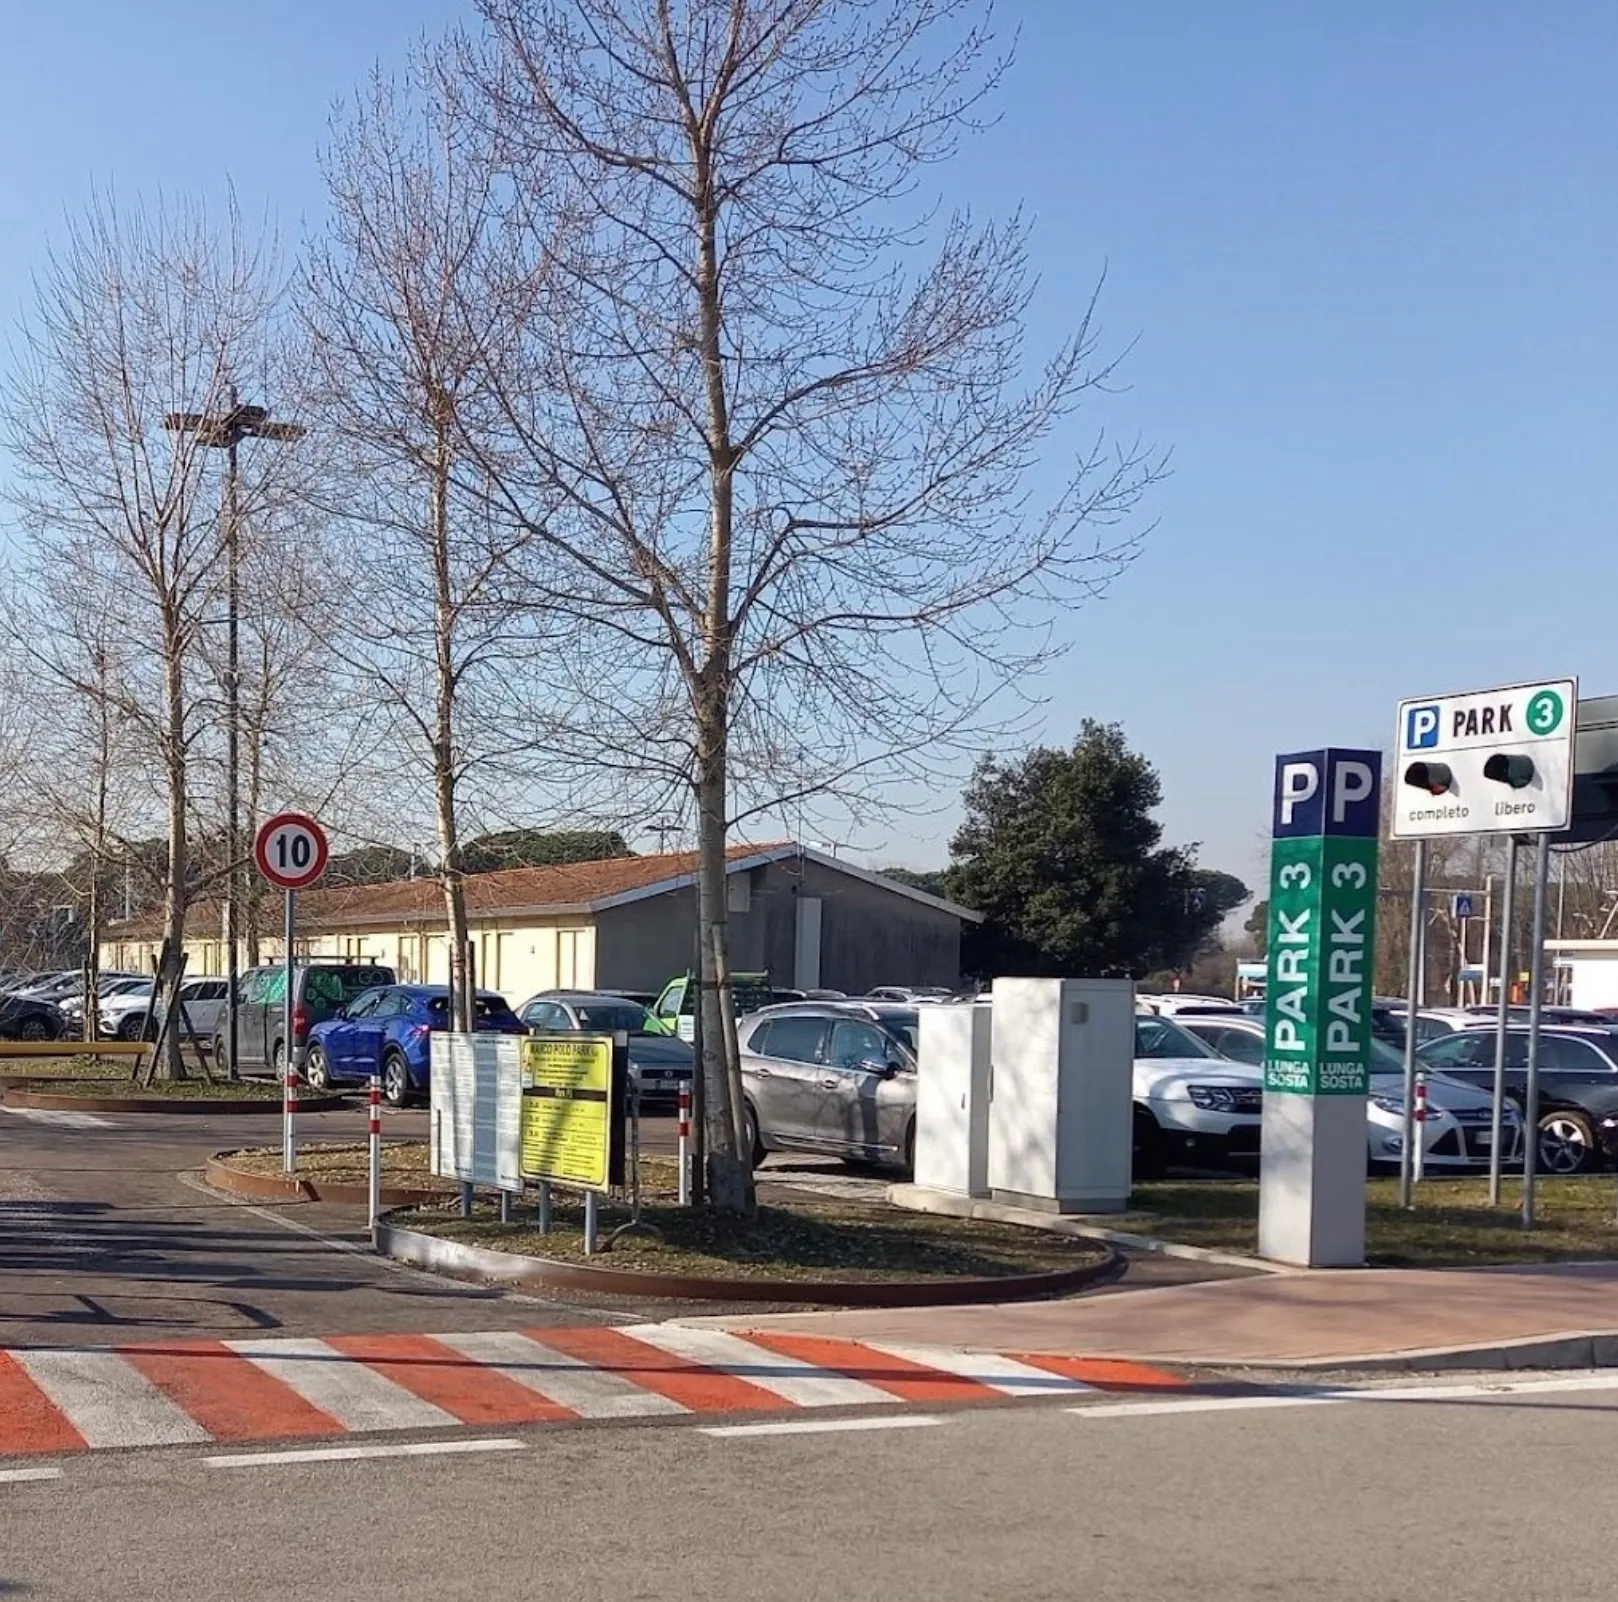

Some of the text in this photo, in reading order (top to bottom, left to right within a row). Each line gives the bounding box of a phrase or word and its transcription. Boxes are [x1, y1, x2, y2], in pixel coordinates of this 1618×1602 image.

[1412, 697, 1554, 747] P PARK 3
[1280, 762, 1319, 825] P
[1332, 760, 1373, 823] P
[1409, 802, 1470, 822] completo
[1494, 801, 1536, 816] libero
[277, 834, 310, 867] 10
[1274, 862, 1312, 1051] PARK 3
[1326, 861, 1367, 1053] PARK 3
[554, 1044, 572, 1056] POLO
[1268, 1060, 1310, 1074] LUNGA
[1320, 1062, 1365, 1075] LUNGA
[1268, 1074, 1309, 1088] SOSTA
[1319, 1075, 1363, 1089] SOSTA
